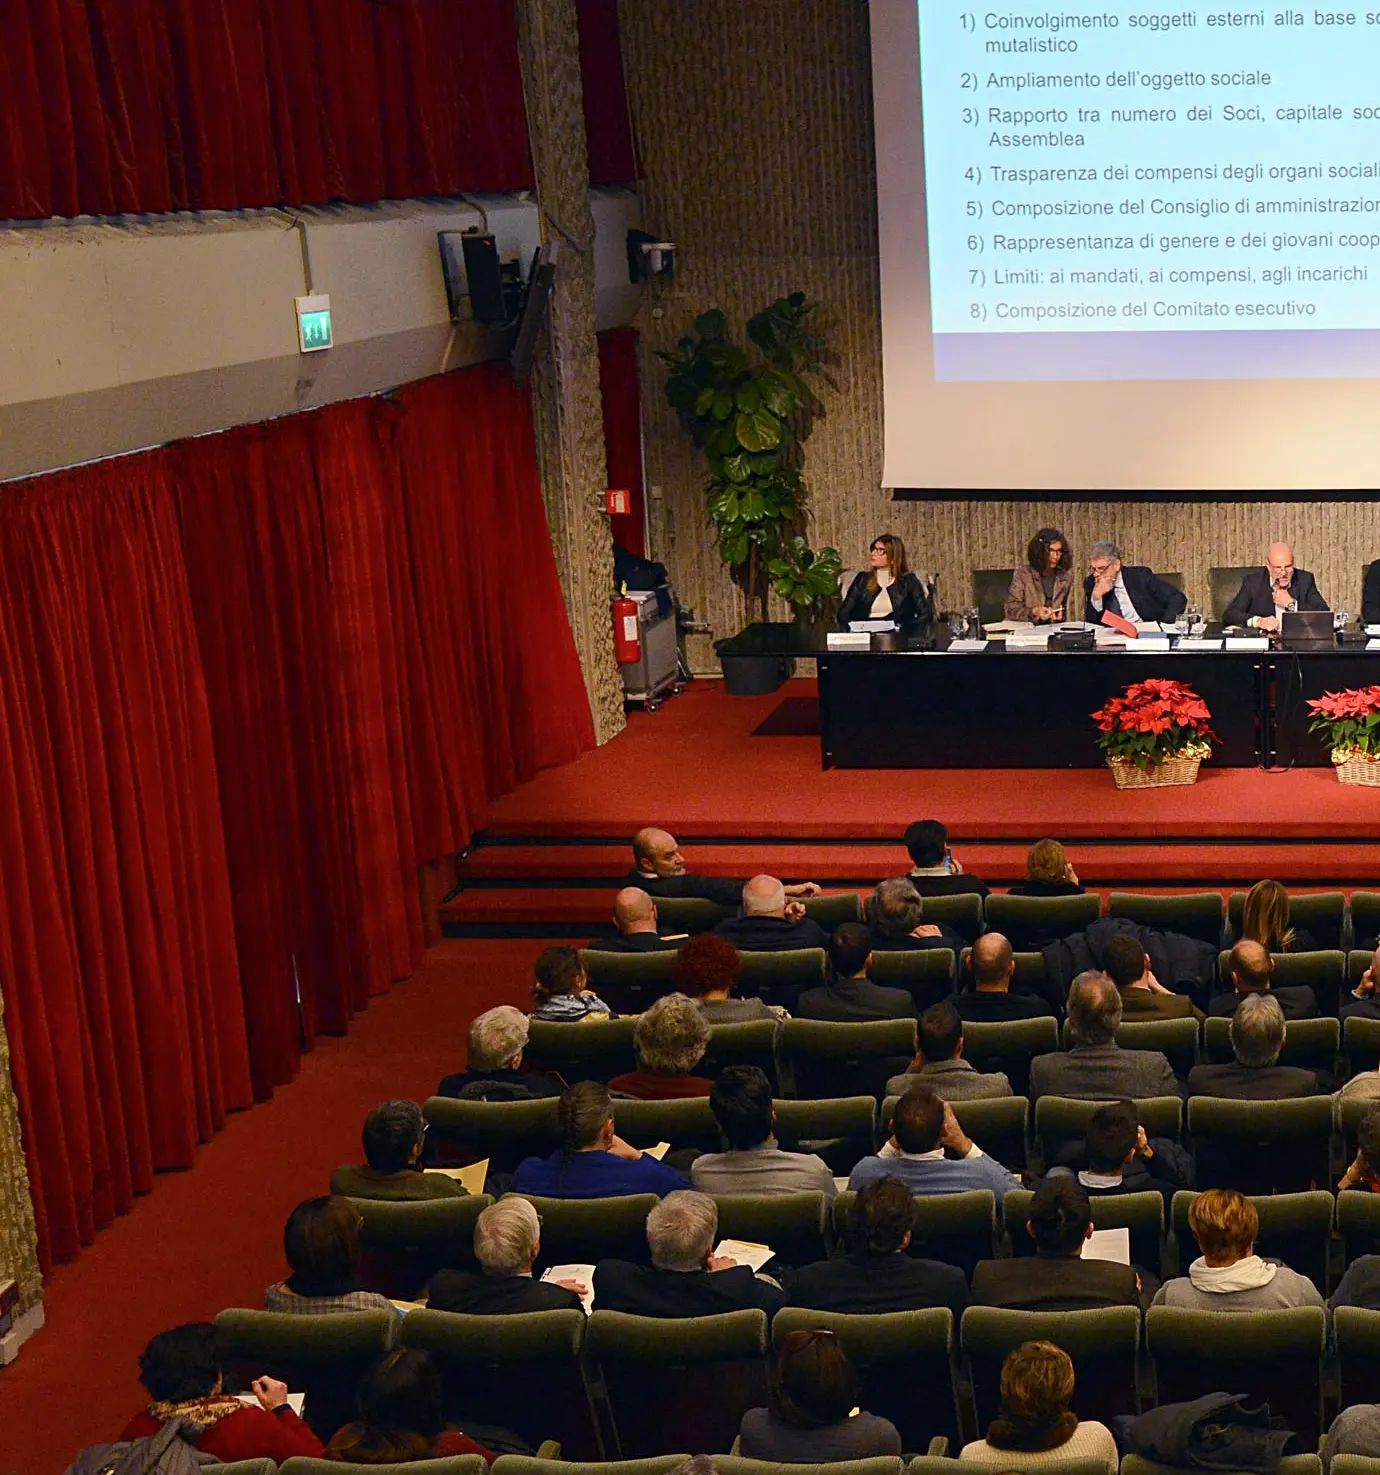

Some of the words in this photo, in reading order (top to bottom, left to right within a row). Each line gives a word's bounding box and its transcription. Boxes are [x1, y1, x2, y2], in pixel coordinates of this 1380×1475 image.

[959, 13, 976, 34] 1)
[984, 11, 1120, 33] Coinvolgimento
[1128, 10, 1197, 32] soggetti
[1206, 9, 1265, 27] esterni
[1273, 9, 1305, 27] alla
[1314, 9, 1357, 26] base
[985, 36, 1079, 54] mutalistico
[960, 71, 979, 93] 2)
[985, 71, 1101, 92] Ampliamento
[1105, 70, 1206, 91] dell'oggetto
[1210, 69, 1272, 87] sociale
[961, 107, 980, 128] 3)
[988, 107, 1069, 127] Rapporto
[1077, 107, 1101, 123] tra
[1111, 108, 1177, 123] numero
[1186, 105, 1213, 122] dei
[1223, 104, 1266, 123] Soci,
[1275, 103, 1343, 125] capitale
[988, 130, 1085, 148] Assemblea
[963, 166, 982, 186] 4)
[989, 165, 1098, 186] Trasparenza
[1103, 164, 1129, 181] dei
[1134, 163, 1218, 185] compensi
[1222, 162, 1264, 183] degli
[1268, 162, 1323, 183] organi
[966, 200, 984, 220] 5)
[991, 199, 1114, 220] Composizione
[1118, 198, 1145, 215] del
[1150, 197, 1231, 219] Consiglio
[1234, 197, 1250, 214] di
[967, 234, 985, 255] 6)
[993, 234, 1134, 255] Rappresentanza
[1139, 232, 1155, 250] di
[1159, 235, 1220, 253] genere
[1224, 235, 1236, 249] e
[1240, 231, 1267, 248] dei
[1271, 231, 1333, 252] giovani
[968, 269, 986, 289] 7)
[994, 268, 1044, 285] Limiti:
[1049, 268, 1065, 285] ai
[1070, 267, 1144, 285] mandati,
[1148, 267, 1164, 284] ai
[1168, 266, 1257, 287] compensi,
[1261, 265, 1292, 286] agli
[1296, 265, 1368, 282] incarichi
[970, 303, 988, 323] 8)
[995, 301, 1117, 321] Composizione
[1121, 301, 1147, 317] del
[1153, 300, 1230, 317] Comitato
[1234, 299, 1317, 317] esecutivo
